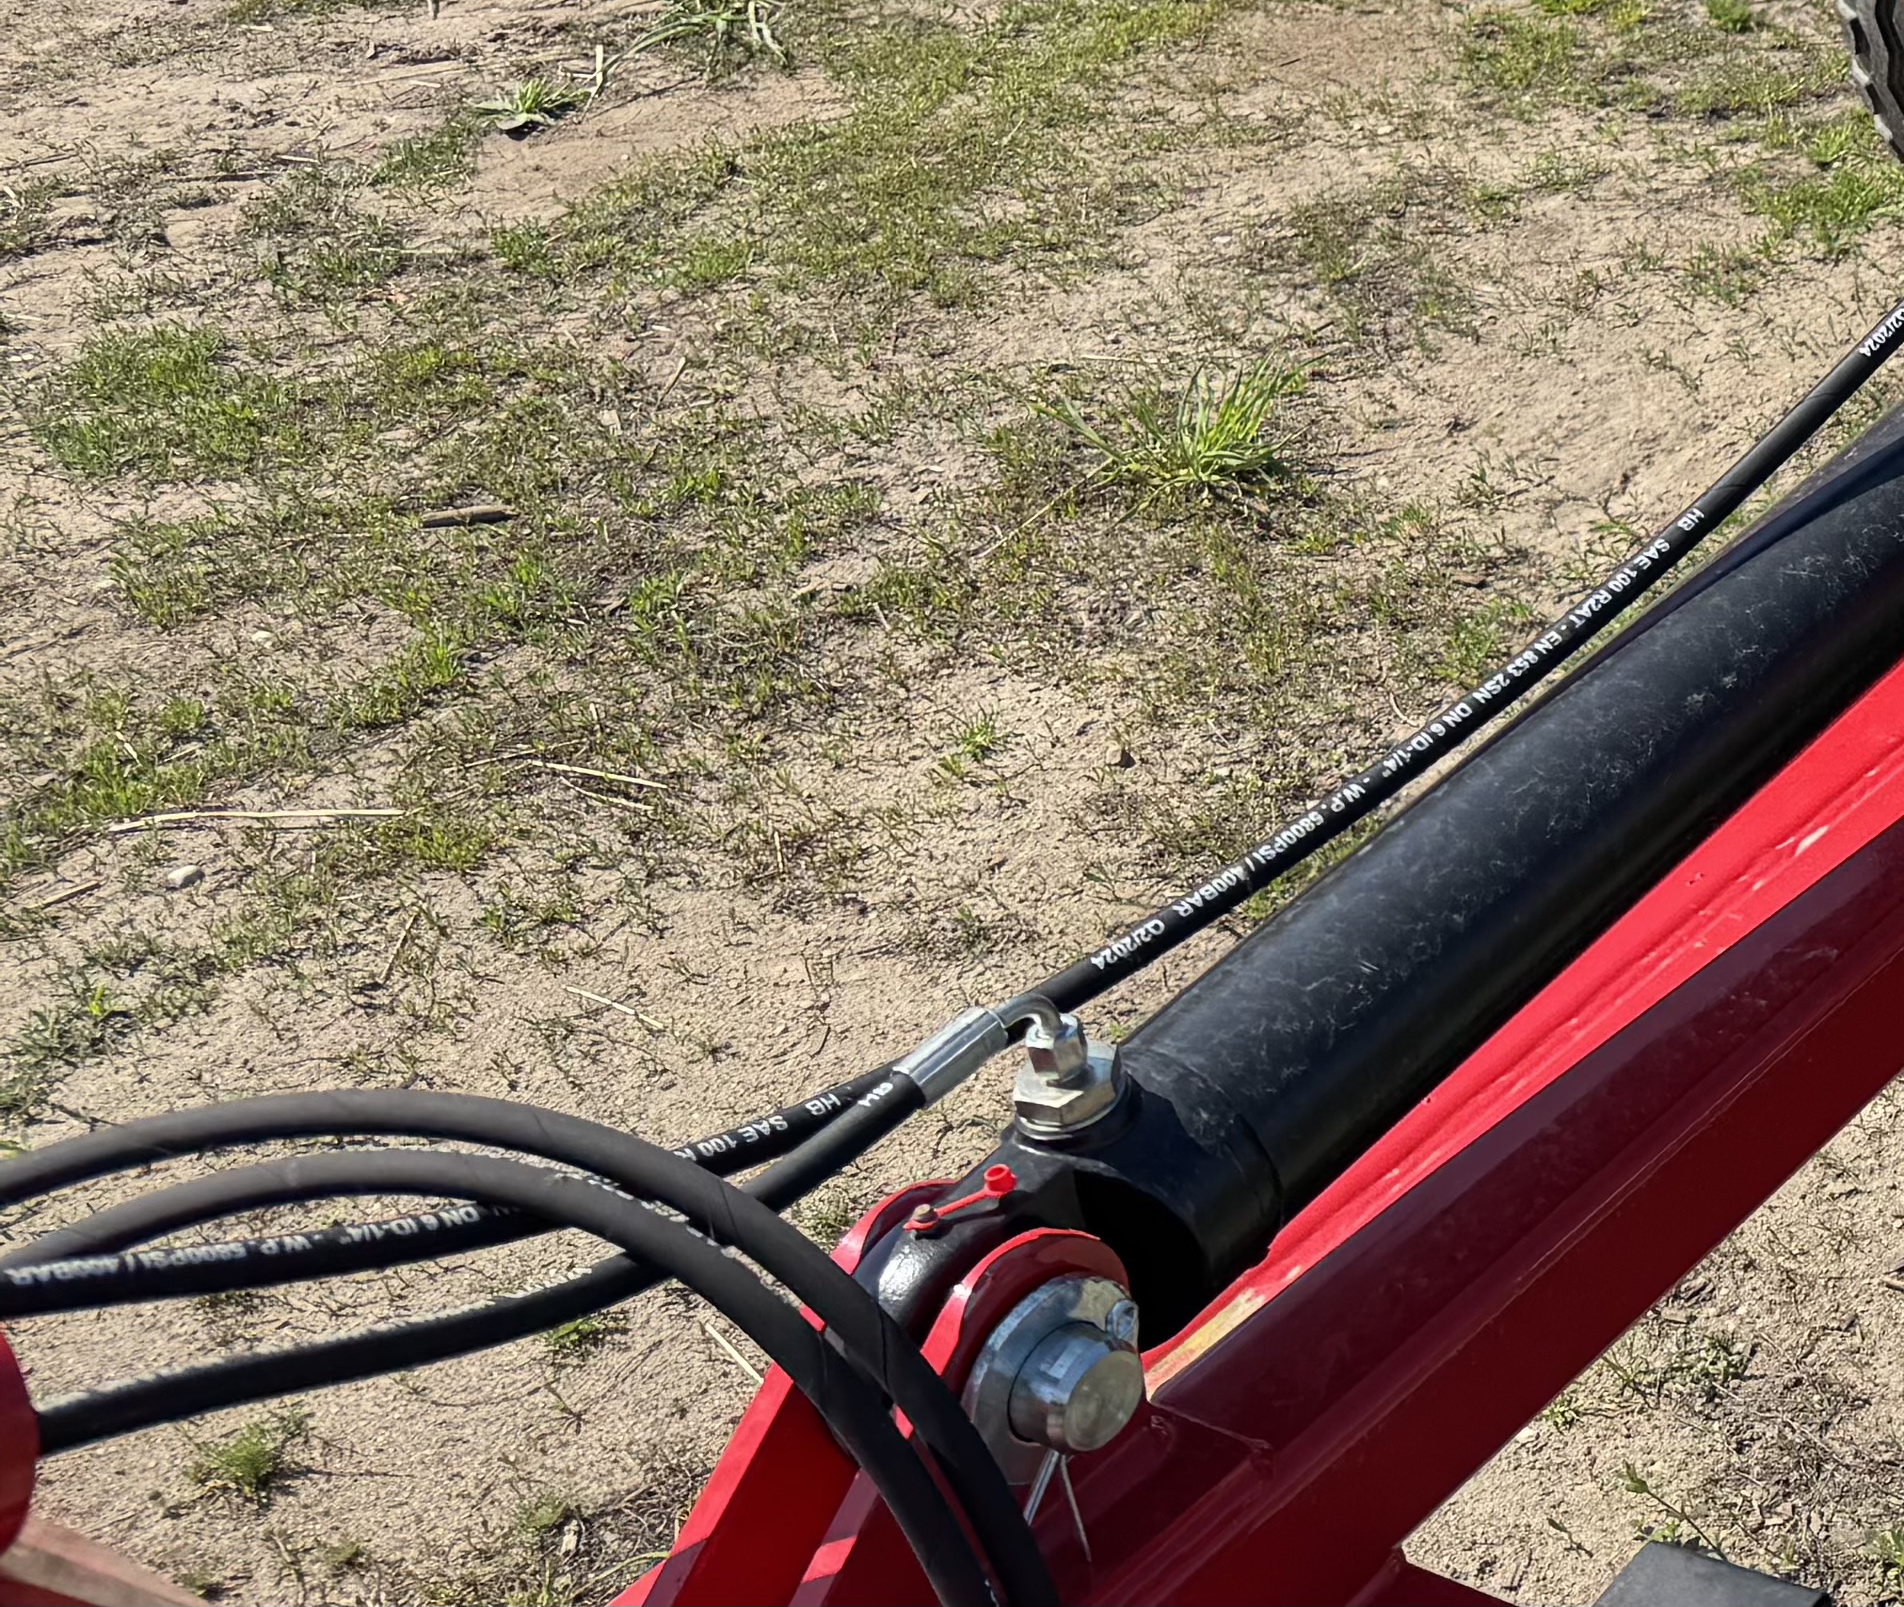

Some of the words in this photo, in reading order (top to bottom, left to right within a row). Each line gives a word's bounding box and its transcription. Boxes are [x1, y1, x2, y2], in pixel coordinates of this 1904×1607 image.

[1677, 505, 1704, 530] HB
[1631, 538, 1669, 569] SAE
[1608, 565, 1637, 591] 100
[1569, 590, 1611, 627] R2AT
[1534, 631, 1562, 653] EN
[1506, 651, 1538, 676] 853
[1091, 919, 1164, 969] Q2/2024
[805, 1093, 840, 1115] HB
[738, 1116, 787, 1142] SAE
[694, 1131, 736, 1154] 100
